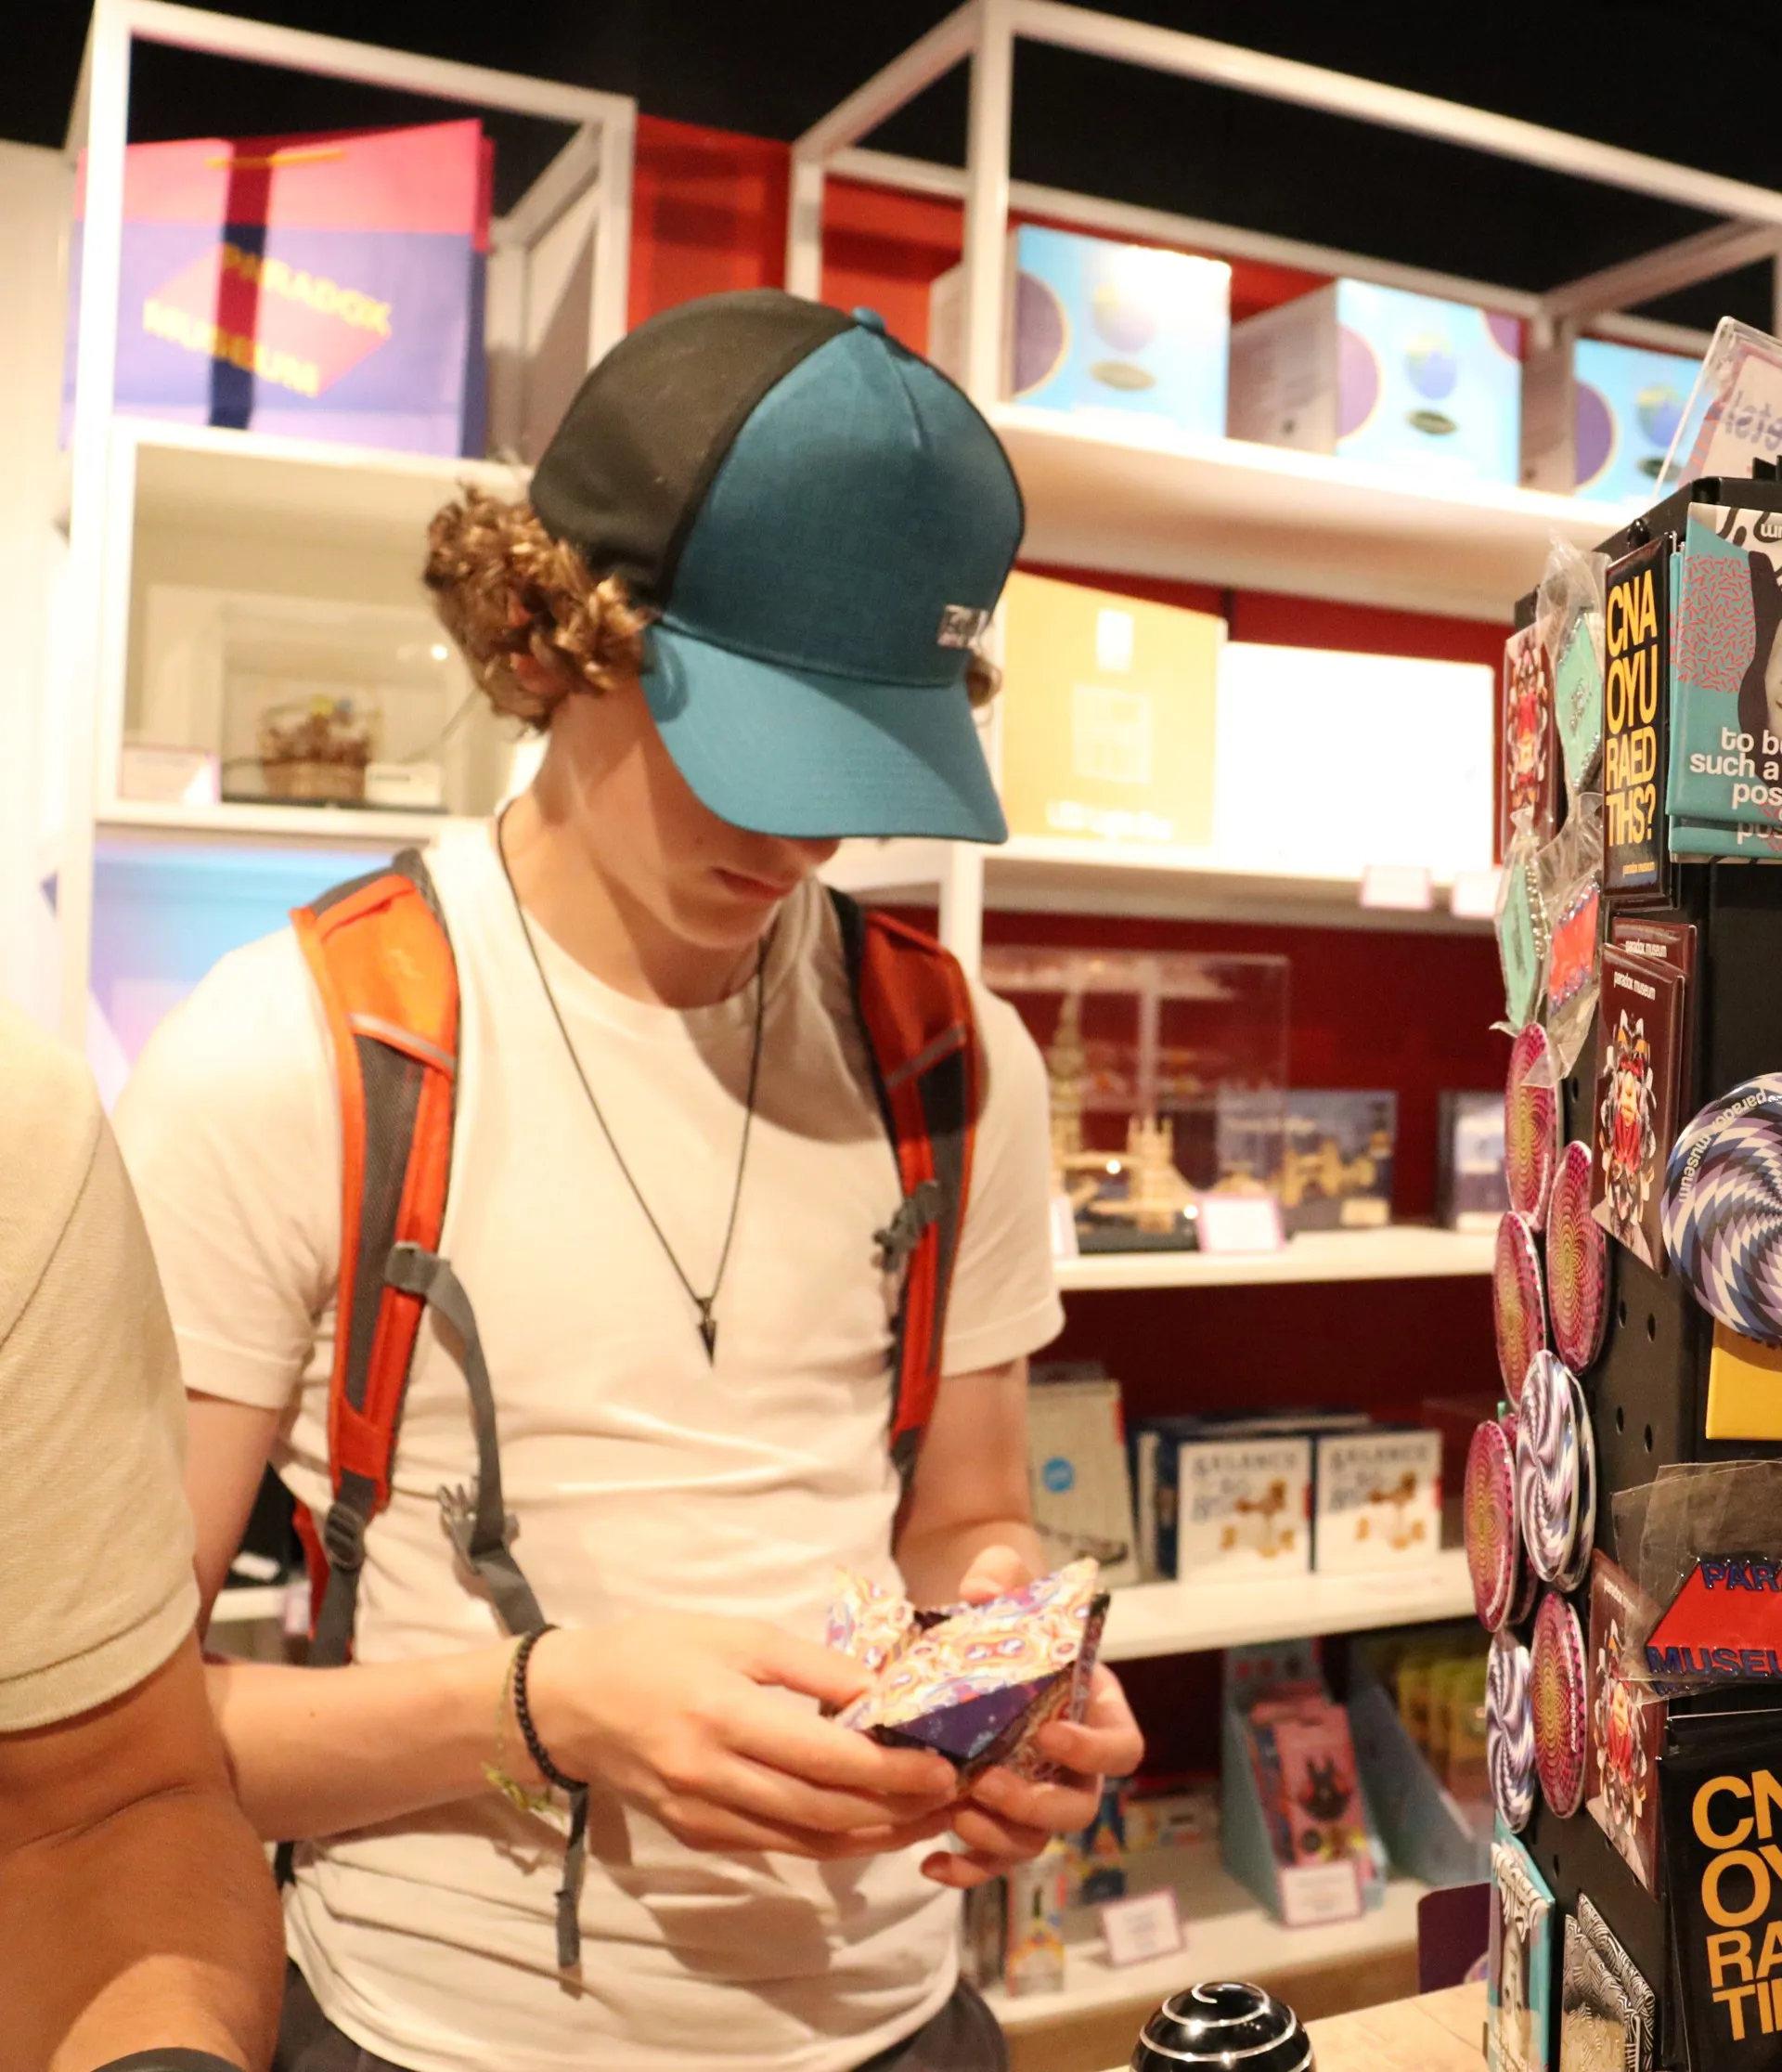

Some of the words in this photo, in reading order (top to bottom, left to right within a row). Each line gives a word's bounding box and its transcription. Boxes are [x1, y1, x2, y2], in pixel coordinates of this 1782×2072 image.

[1607, 569, 1658, 657] CNA
[1607, 643, 1658, 735] OYU
[1606, 725, 1658, 792] RAED
[1689, 752, 1756, 778] such
[1763, 760, 1779, 781] a
[1721, 726, 1754, 753] to
[1762, 730, 1782, 756] b
[1606, 783, 1658, 848] TIHS?
[1679, 1133, 1712, 1204] museum
[1701, 1562, 1782, 1592] PAR
